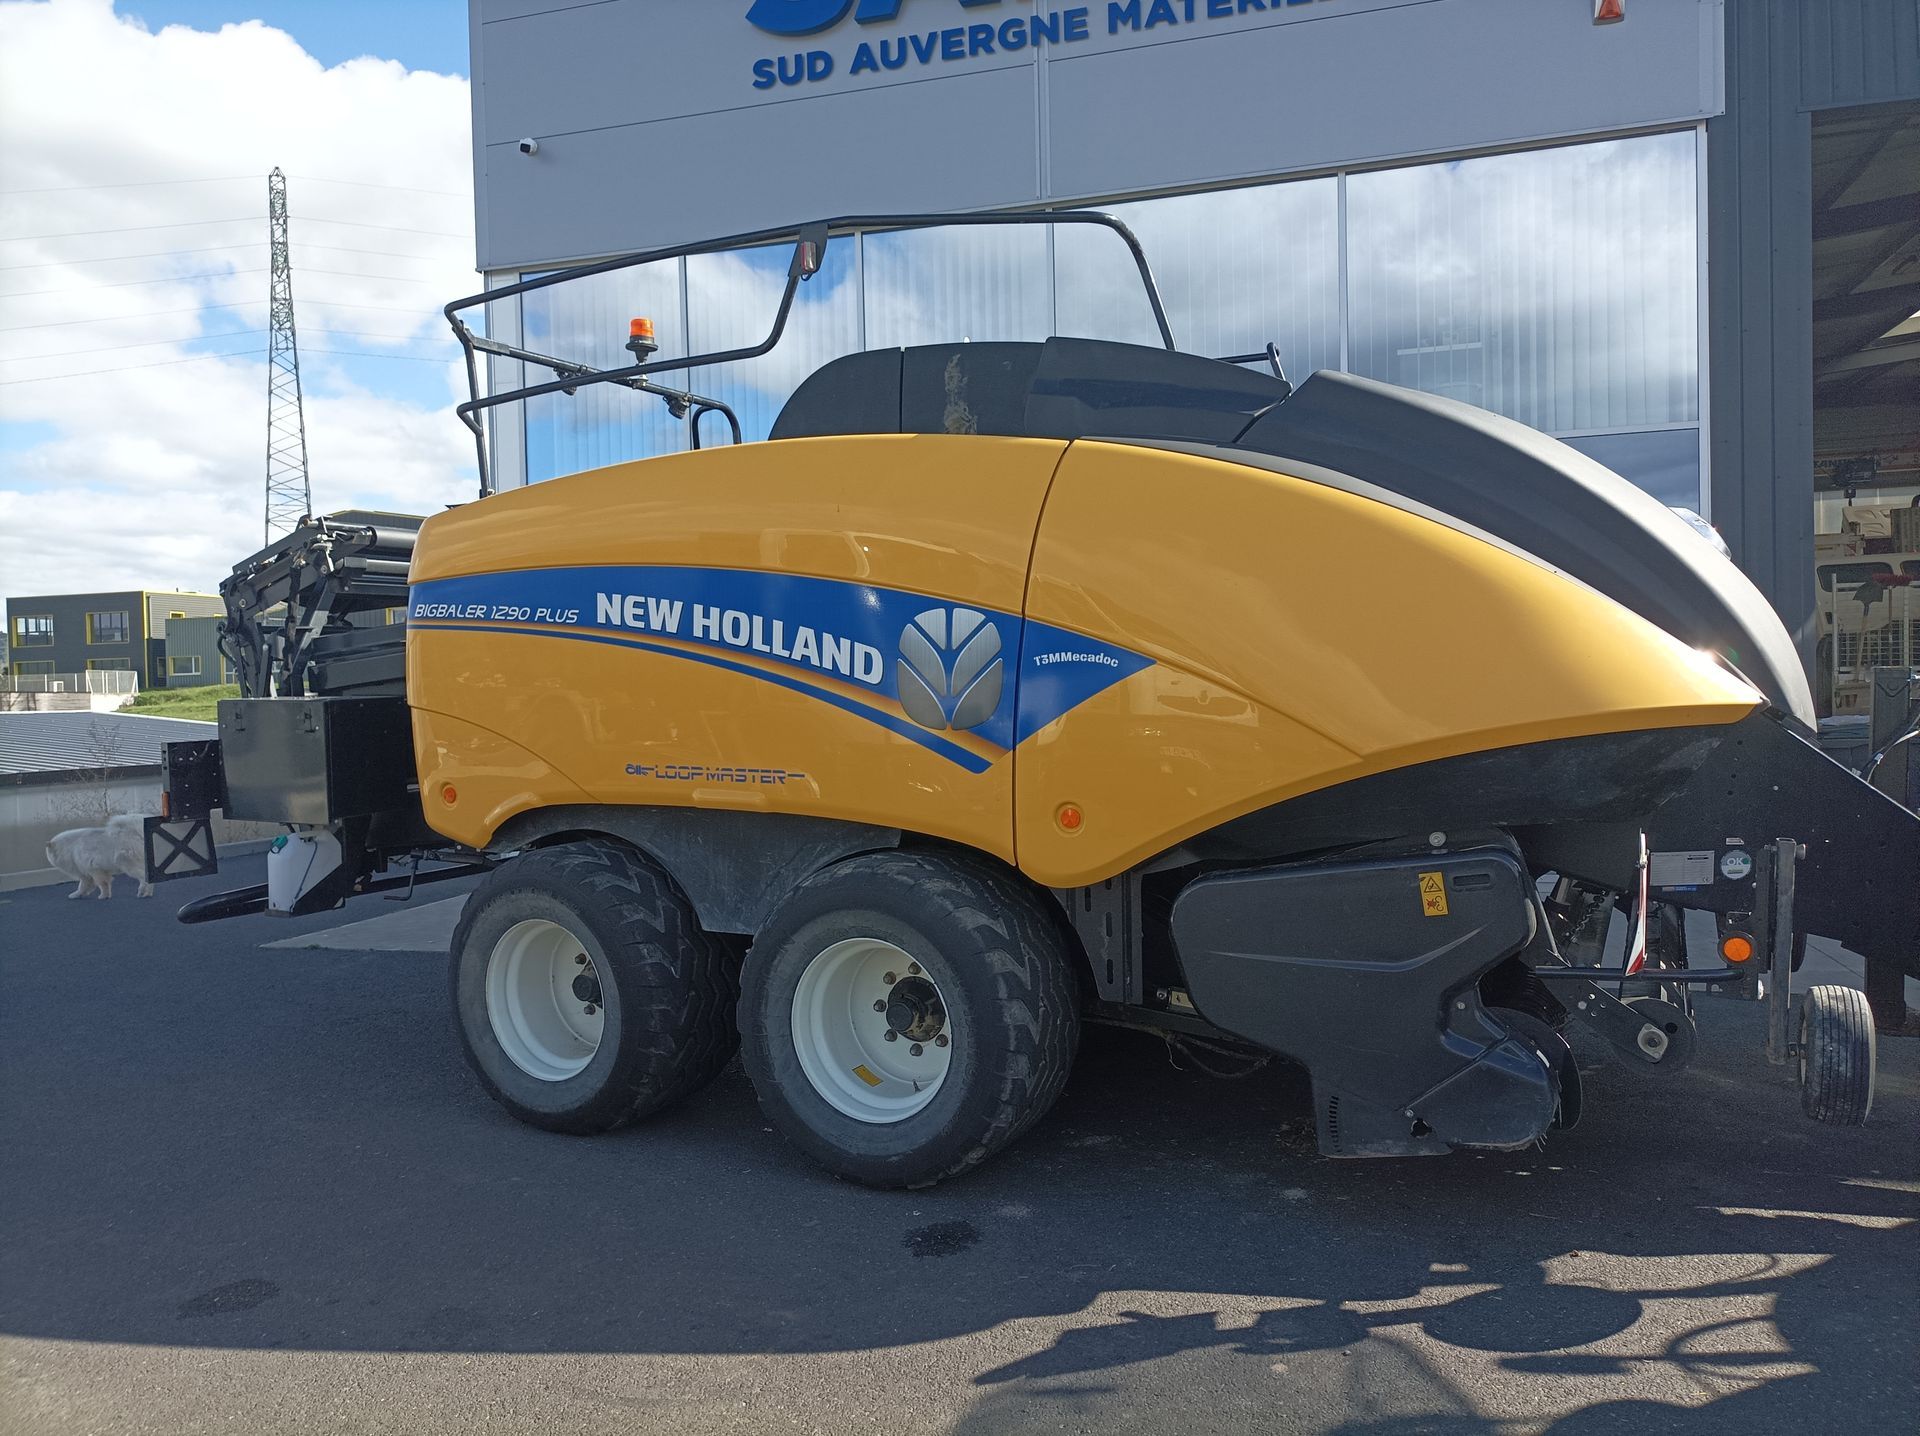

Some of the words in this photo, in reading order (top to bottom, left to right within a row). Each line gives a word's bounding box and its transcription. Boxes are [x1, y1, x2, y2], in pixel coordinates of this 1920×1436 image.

[752, 50, 834, 90] SUD
[849, 7, 1089, 74] AUVERGNE
[415, 604, 487, 618] BIGBALER
[491, 606, 531, 620] 1290
[534, 609, 579, 623] PLUS
[596, 592, 683, 633] NEW
[693, 603, 884, 685] HOLLAND
[1033, 651, 1119, 667] T3MMecadoc
[1726, 857, 1744, 866] OK
